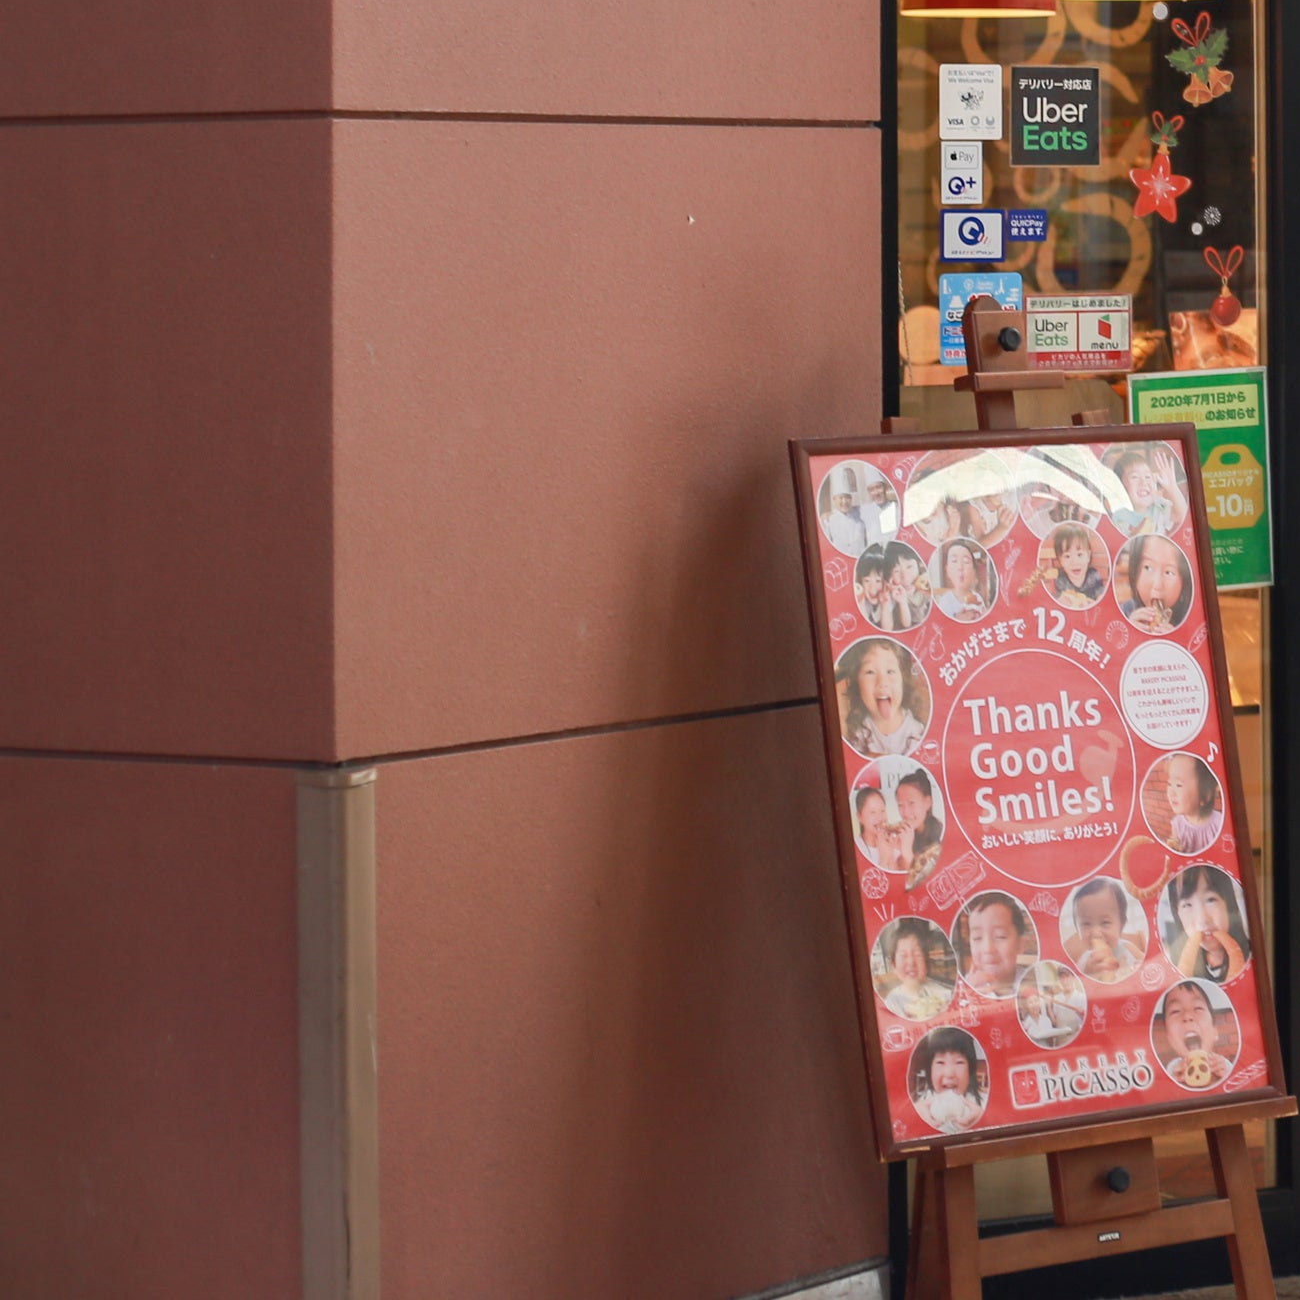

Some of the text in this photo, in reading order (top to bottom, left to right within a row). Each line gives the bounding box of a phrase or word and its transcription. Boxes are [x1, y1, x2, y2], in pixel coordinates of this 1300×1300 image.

[1018, 78, 1092, 91] デリバリー対応店
[1022, 96, 1088, 124] Uber
[1022, 125, 1088, 151] Eats
[959, 151, 974, 163] Pay
[1010, 219, 1044, 228] QUICPay
[1035, 318, 1068, 332] Uber
[1035, 333, 1068, 347] Eats
[1091, 341, 1119, 350] menu
[1150, 390, 1247, 409] 2020年7月1日から
[1208, 475, 1255, 489] エコバッグ
[963, 690, 1102, 737] Thanks
[970, 734, 1076, 780] Good
[975, 776, 1115, 825] Smiles!
[981, 821, 1119, 850] おいしい笑顔に、ありがとう！
[1041, 1050, 1146, 1076] BAKERY
[1044, 1064, 1152, 1100] PICASSO
